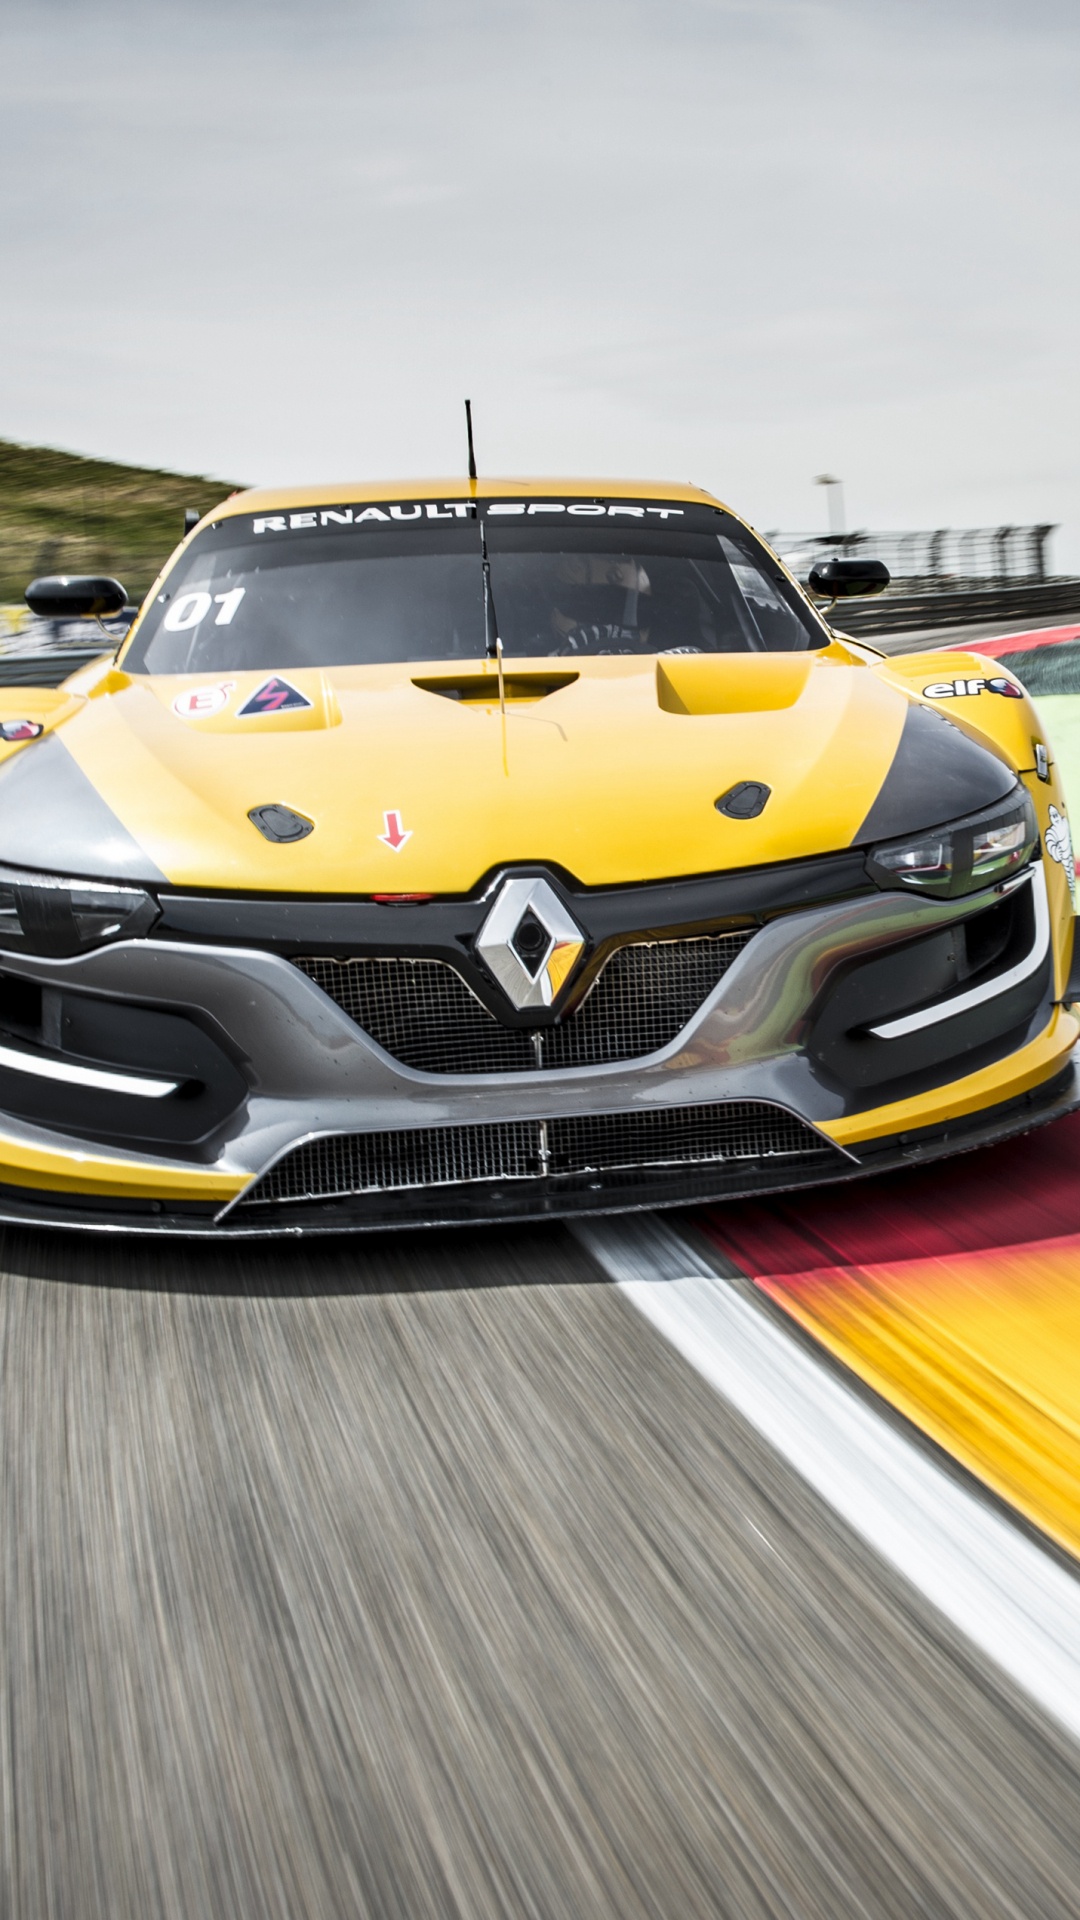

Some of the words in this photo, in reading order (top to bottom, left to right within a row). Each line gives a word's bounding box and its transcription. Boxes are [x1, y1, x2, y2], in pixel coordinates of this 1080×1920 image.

[252, 502, 477, 534] RENAULT
[487, 503, 685, 520] SPORT
[163, 587, 246, 632] 01
[923, 679, 987, 698] elf
[189, 692, 213, 711] E
